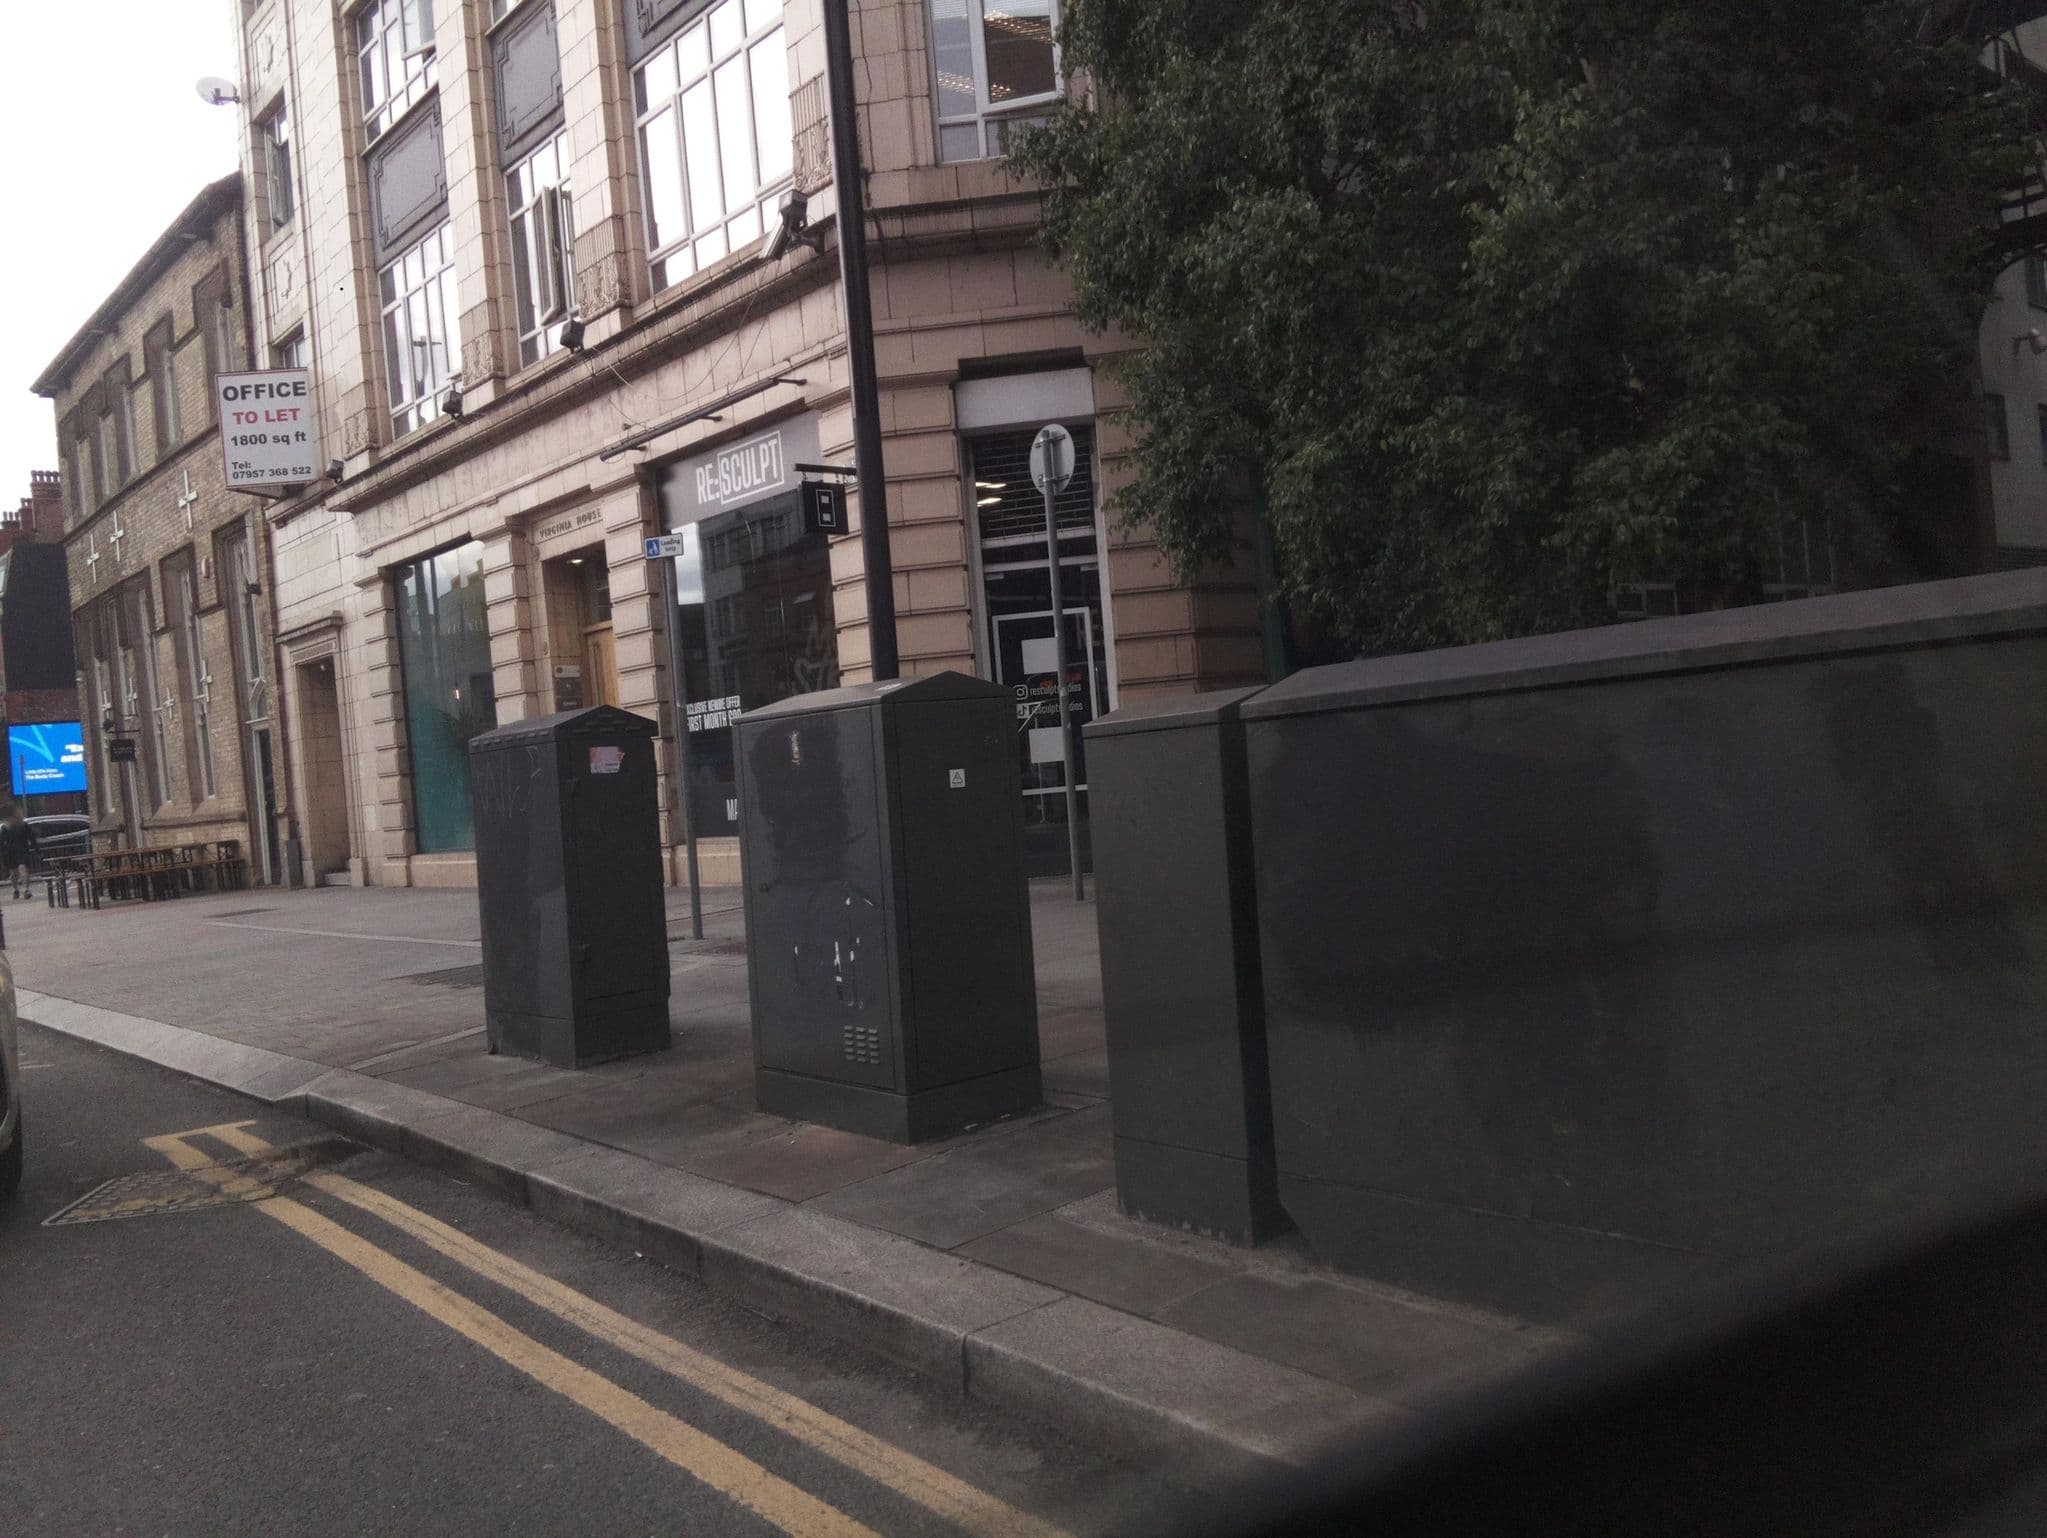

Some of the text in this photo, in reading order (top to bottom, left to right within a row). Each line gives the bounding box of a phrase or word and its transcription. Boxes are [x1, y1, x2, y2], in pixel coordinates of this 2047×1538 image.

[222, 381, 307, 402] OFFICE
[232, 408, 301, 425] TO LET
[230, 431, 307, 447] 1800 sq ft
[231, 461, 252, 471] Tel:
[231, 466, 312, 480] 07957 368 522
[539, 508, 602, 538] VIRGINIA HOUSE
[703, 710, 728, 730] MONTH
